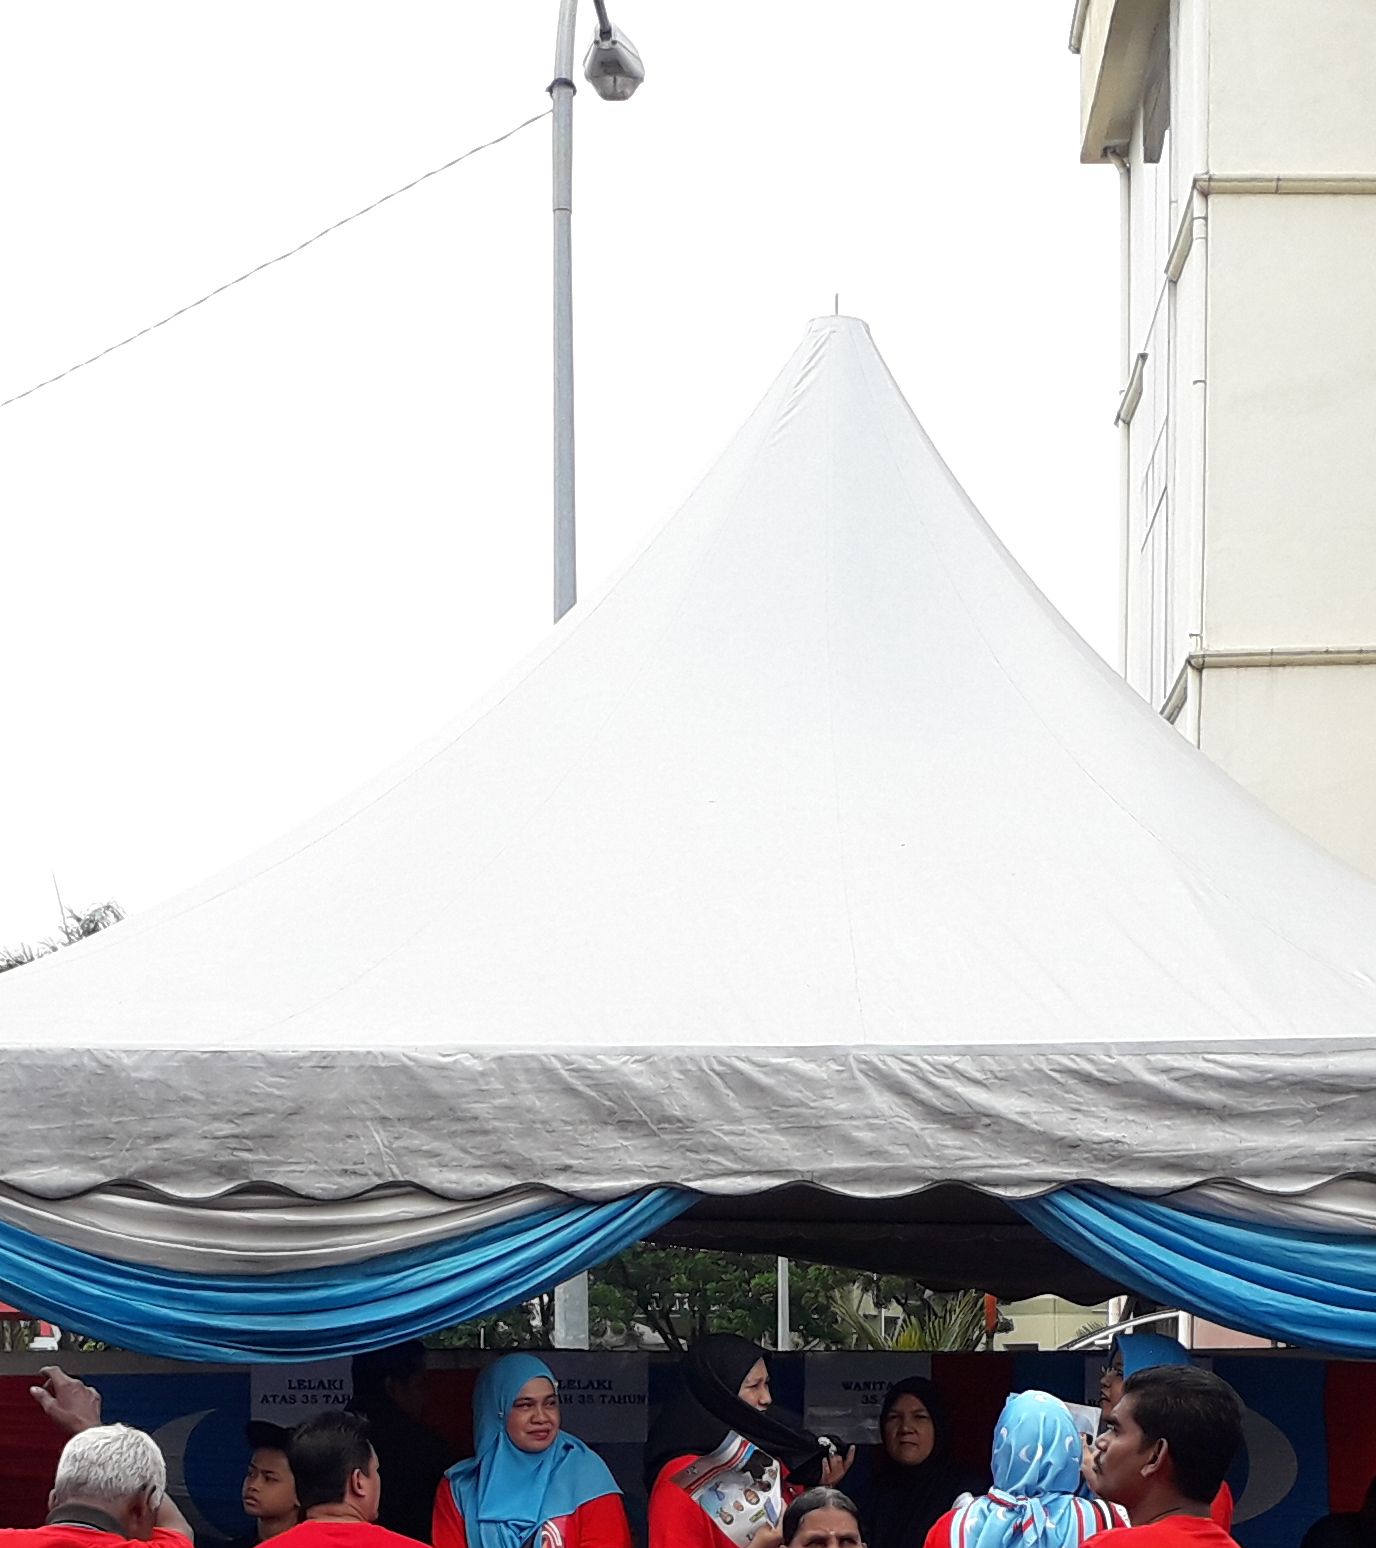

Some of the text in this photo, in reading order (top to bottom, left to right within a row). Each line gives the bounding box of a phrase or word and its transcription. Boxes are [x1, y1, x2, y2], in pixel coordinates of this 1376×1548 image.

[288, 1379, 344, 1390] LELAKI
[558, 1379, 612, 1390] LELAKI
[261, 1394, 351, 1404] ATAS 35 TAH
[578, 1394, 594, 1404] 35
[599, 1394, 646, 1404] TAHUN
